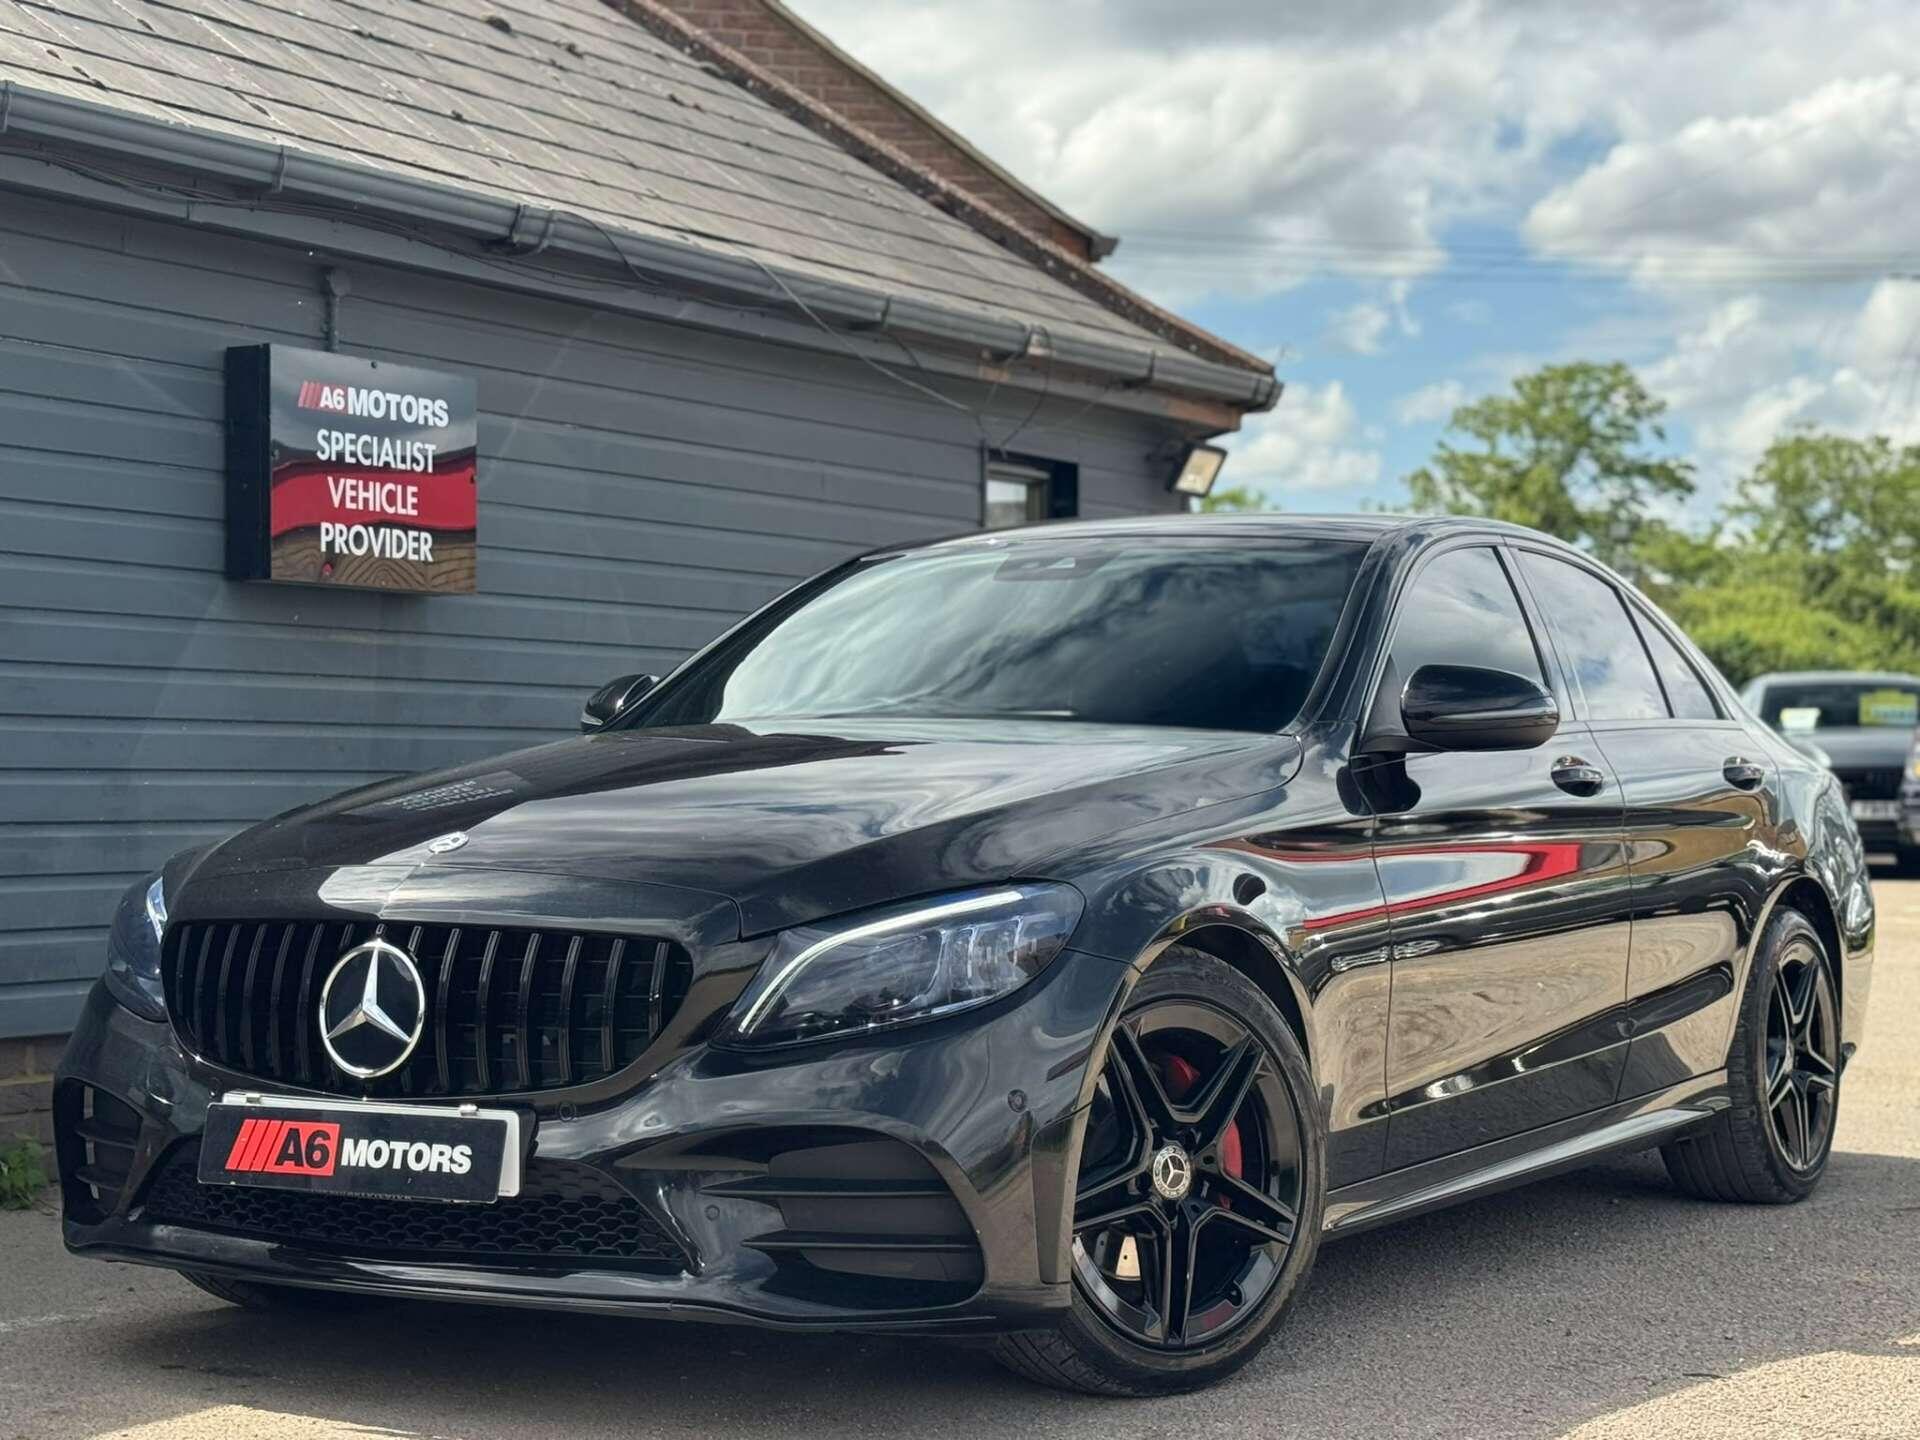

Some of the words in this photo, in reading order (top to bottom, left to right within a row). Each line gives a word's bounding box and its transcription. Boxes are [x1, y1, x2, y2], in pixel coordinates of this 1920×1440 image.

[319, 386, 345, 410] A6
[347, 387, 449, 427] MOTORS
[316, 429, 436, 473] SPECIALIST
[327, 476, 418, 516] VEHICLE
[320, 522, 433, 562] PROVIDER
[275, 1127, 331, 1169] A6
[340, 1137, 472, 1175] MOTORS
